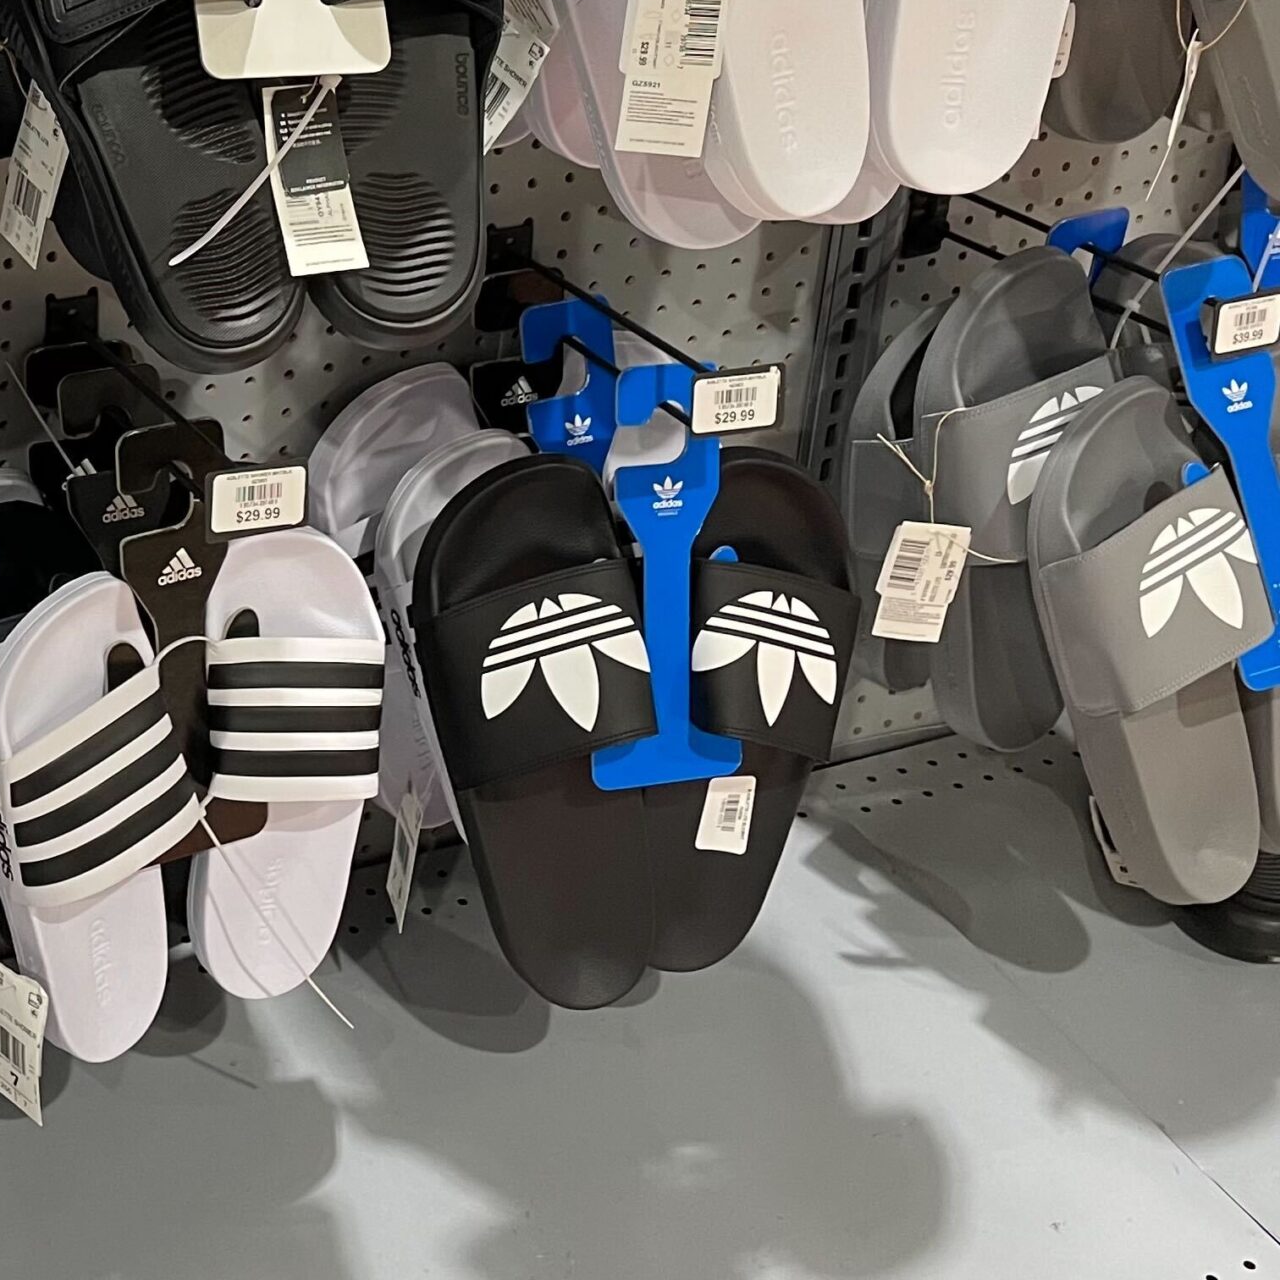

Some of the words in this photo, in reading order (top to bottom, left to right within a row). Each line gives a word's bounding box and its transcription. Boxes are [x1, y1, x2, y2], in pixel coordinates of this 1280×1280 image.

[1233, 328, 1264, 345] $39.99
[501, 392, 539, 407] adidas
[714, 409, 755, 424] $29.99
[567, 434, 594, 446] adidas
[652, 499, 683, 509] adidas
[102, 507, 145, 523] adidas
[236, 507, 280, 523] $29.99
[158, 566, 202, 586] adidas
[10, 1071, 19, 1086] 7
